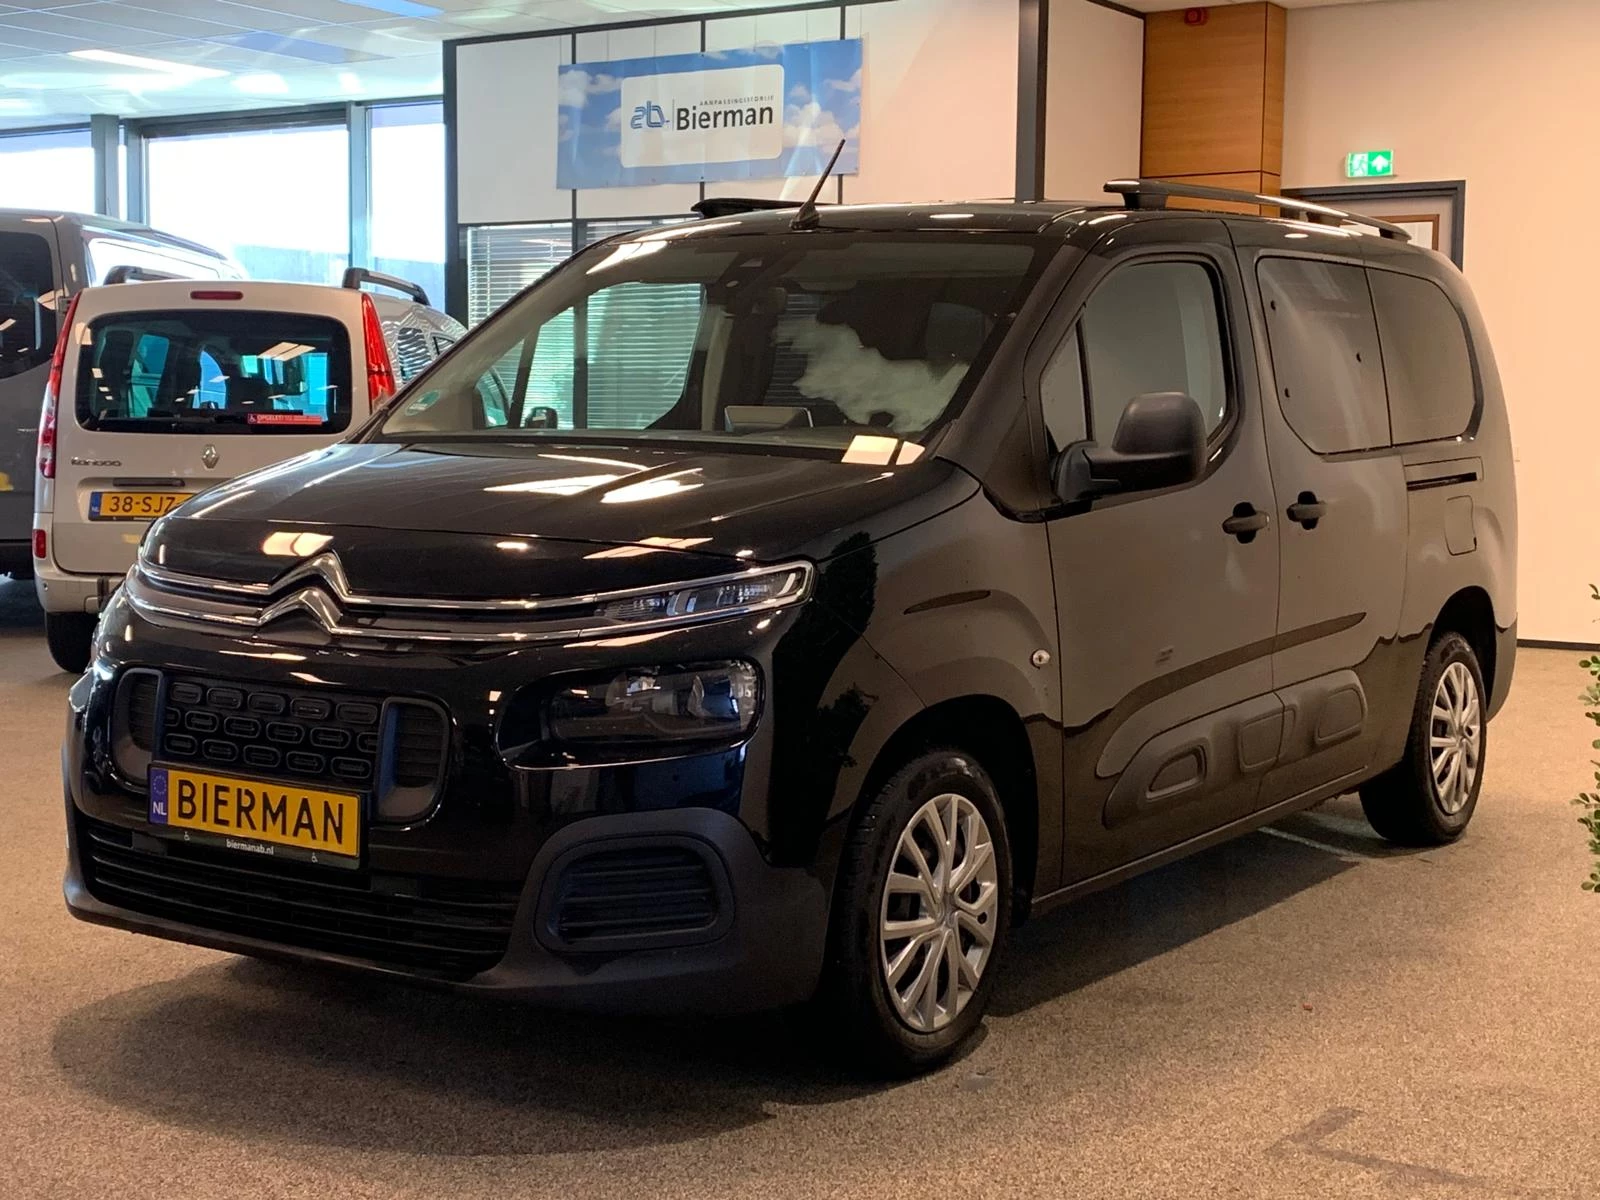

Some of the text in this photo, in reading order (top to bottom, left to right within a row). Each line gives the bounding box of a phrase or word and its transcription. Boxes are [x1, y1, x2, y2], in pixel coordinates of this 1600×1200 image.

[676, 105, 774, 131] Bierman
[109, 496, 177, 513] 38-SJZ
[152, 801, 168, 816] NL
[177, 779, 344, 845] BIERMAN
[226, 838, 275, 856] biermanab.nl
